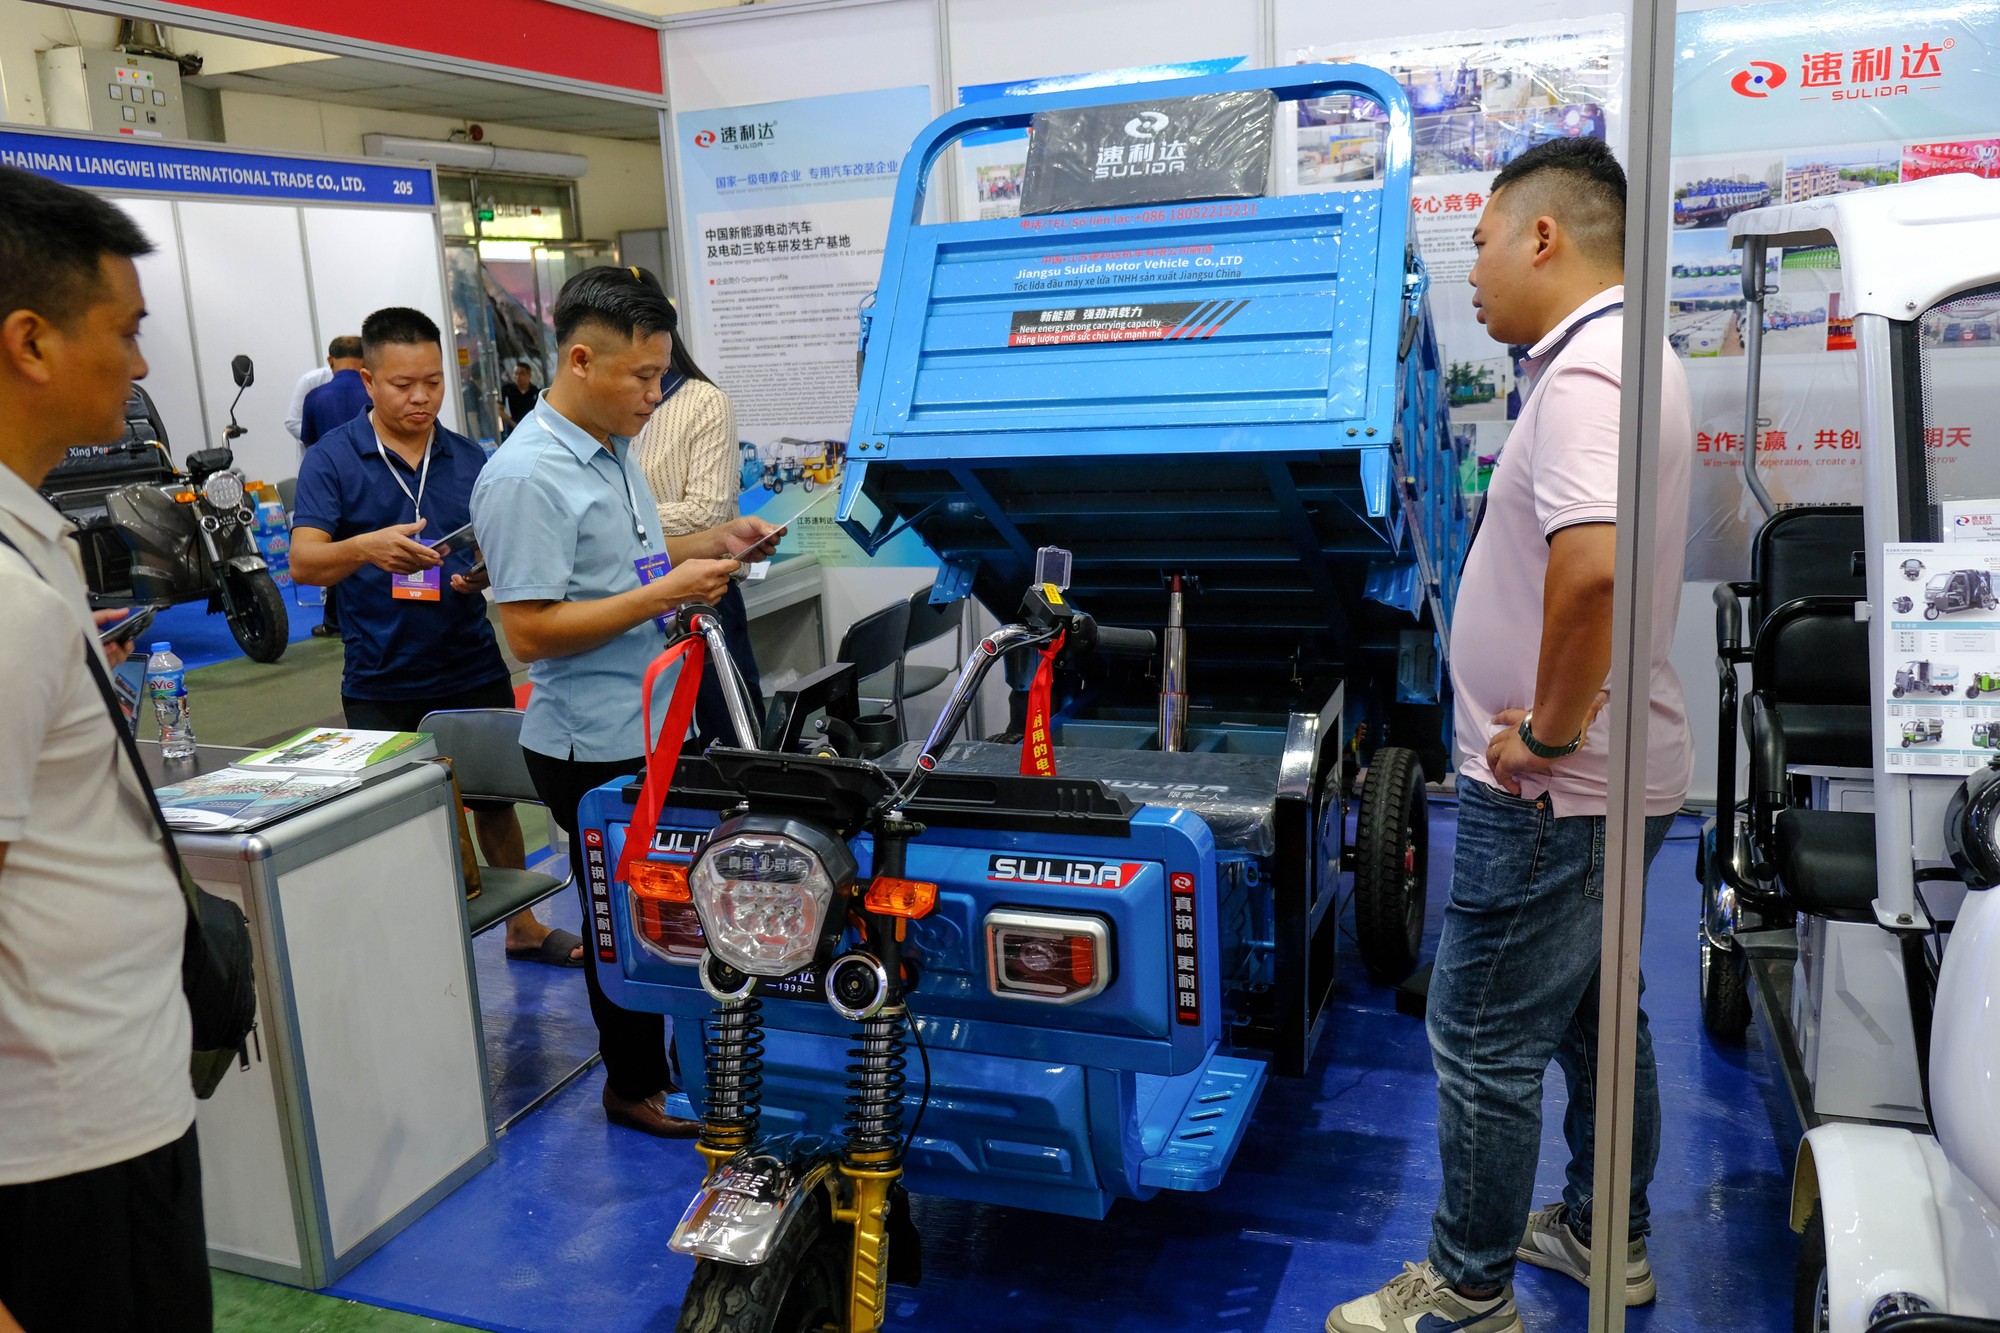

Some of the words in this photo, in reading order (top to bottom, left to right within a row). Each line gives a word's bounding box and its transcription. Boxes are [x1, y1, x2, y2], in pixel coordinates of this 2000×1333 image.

[1800, 42, 1943, 88] 速利达
[1832, 85, 1908, 101] SULIDA
[720, 122, 775, 144] 速利达
[734, 142, 763, 150] SULIDA
[1096, 140, 1187, 166] 速利达
[1, 151, 72, 172] HAINAN
[75, 156, 155, 178] LIANGWEI
[157, 162, 270, 186] INTERNATIONAL
[271, 171, 315, 189] TRADE
[316, 174, 340, 192] CO.,
[341, 176, 366, 192] LTD.
[393, 180, 413, 195] 205
[715, 169, 802, 189] 国家一级电摩企业
[808, 160, 899, 179] 专用汽车改装企业
[1095, 160, 1186, 179] SULIDA
[1169, 202, 1258, 222] 18052215211
[1411, 193, 1490, 213] 心竞争
[705, 220, 812, 242] 中国新能源电动汽车
[706, 234, 851, 259] 及电动三轮车研发生产基地
[1016, 268, 1061, 280] Jiangsu
[1064, 263, 1102, 275] Sulida
[1105, 261, 1142, 272] Motor
[1144, 257, 1190, 270] Vehicle
[1195, 255, 1243, 268] Co.,LTD
[741, 275, 770, 284] Company
[770, 273, 789, 281] profile
[1064, 276, 1083, 289] máy
[1085, 278, 1095, 286] xe
[1112, 273, 1138, 284] TNHH
[1140, 271, 1155, 283] sản
[1156, 270, 1177, 281] xuất
[1179, 269, 1214, 282] Jiangsu
[1215, 268, 1242, 279] China
[1040, 309, 1076, 322] 新能源
[1082, 307, 1143, 320] 强劲承载力
[1020, 325, 1037, 333] New
[1038, 323, 1065, 334] energy
[1066, 322, 1091, 332] strong
[1092, 320, 1126, 331] carrying
[1127, 318, 1162, 329] capacity
[1016, 335, 1036, 345] Năng
[1124, 329, 1148, 341] mạnh
[69, 446, 91, 458] Xing
[1815, 457, 1847, 467] create
[409, 590, 423, 598] VIP
[149, 679, 175, 690] aVie
[994, 858, 1122, 887] SULIDA
[778, 982, 803, 993] 1998
